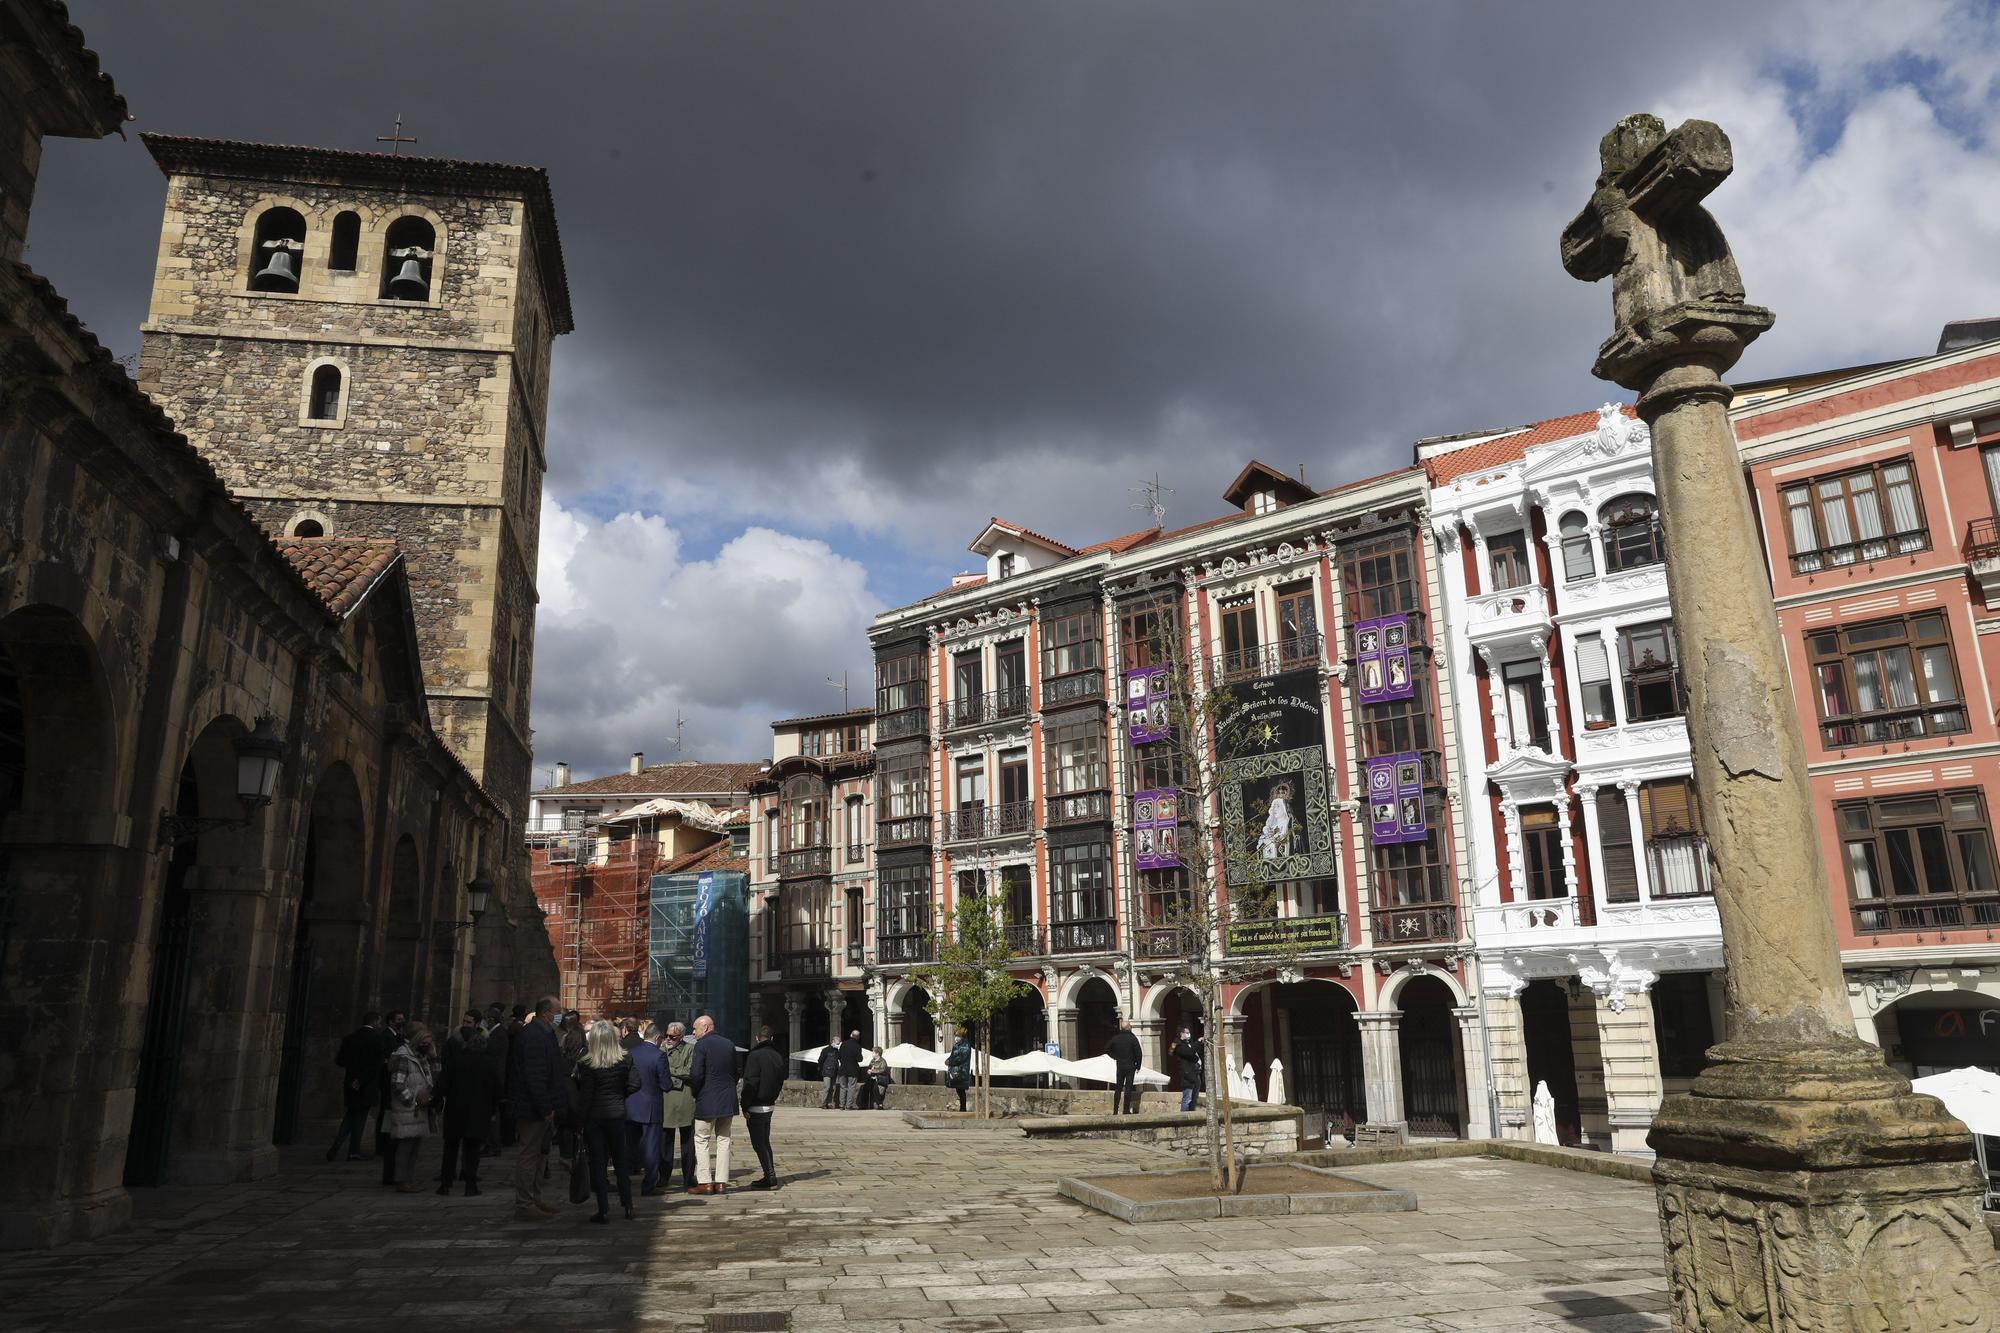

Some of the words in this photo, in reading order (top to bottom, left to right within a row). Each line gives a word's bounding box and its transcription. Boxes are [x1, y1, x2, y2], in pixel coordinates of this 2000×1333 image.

[1268, 695, 1276, 705] de
[1277, 695, 1288, 705] los
[1289, 695, 1319, 715] Dolores
